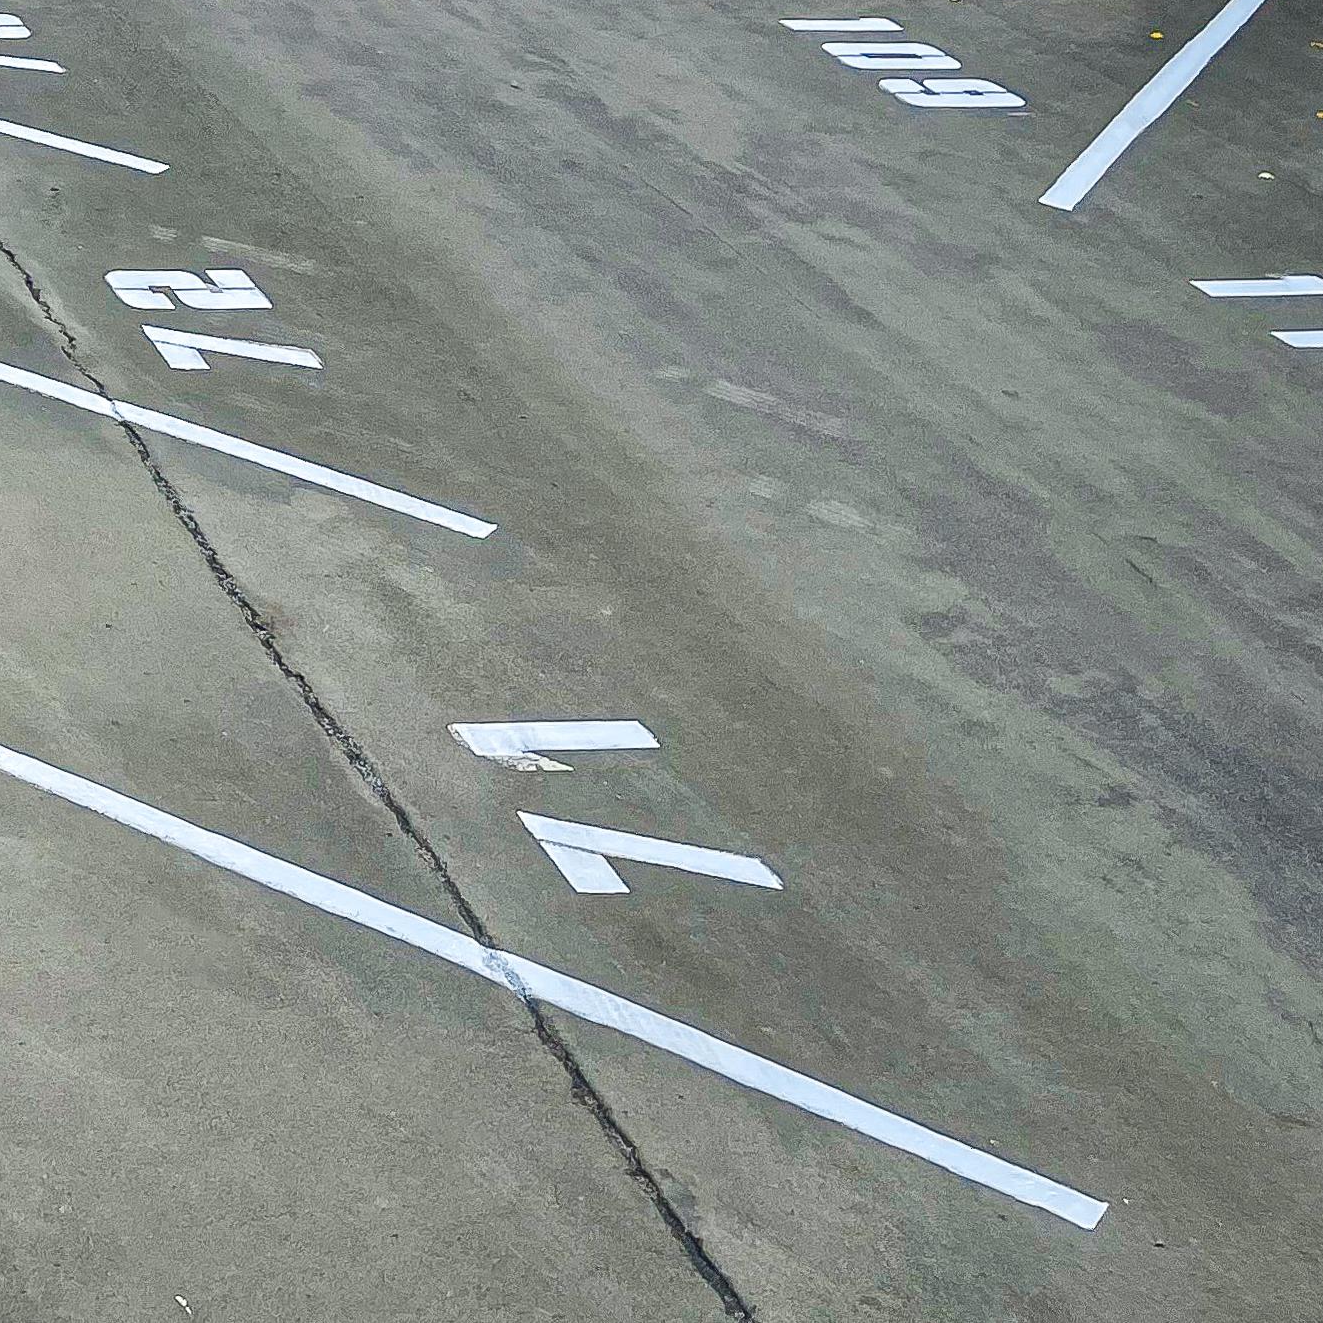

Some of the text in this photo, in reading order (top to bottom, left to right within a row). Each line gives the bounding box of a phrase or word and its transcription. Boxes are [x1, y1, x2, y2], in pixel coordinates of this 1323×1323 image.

[779, 18, 1025, 107] 109
[105, 270, 322, 370] 72
[448, 721, 783, 893] 71
